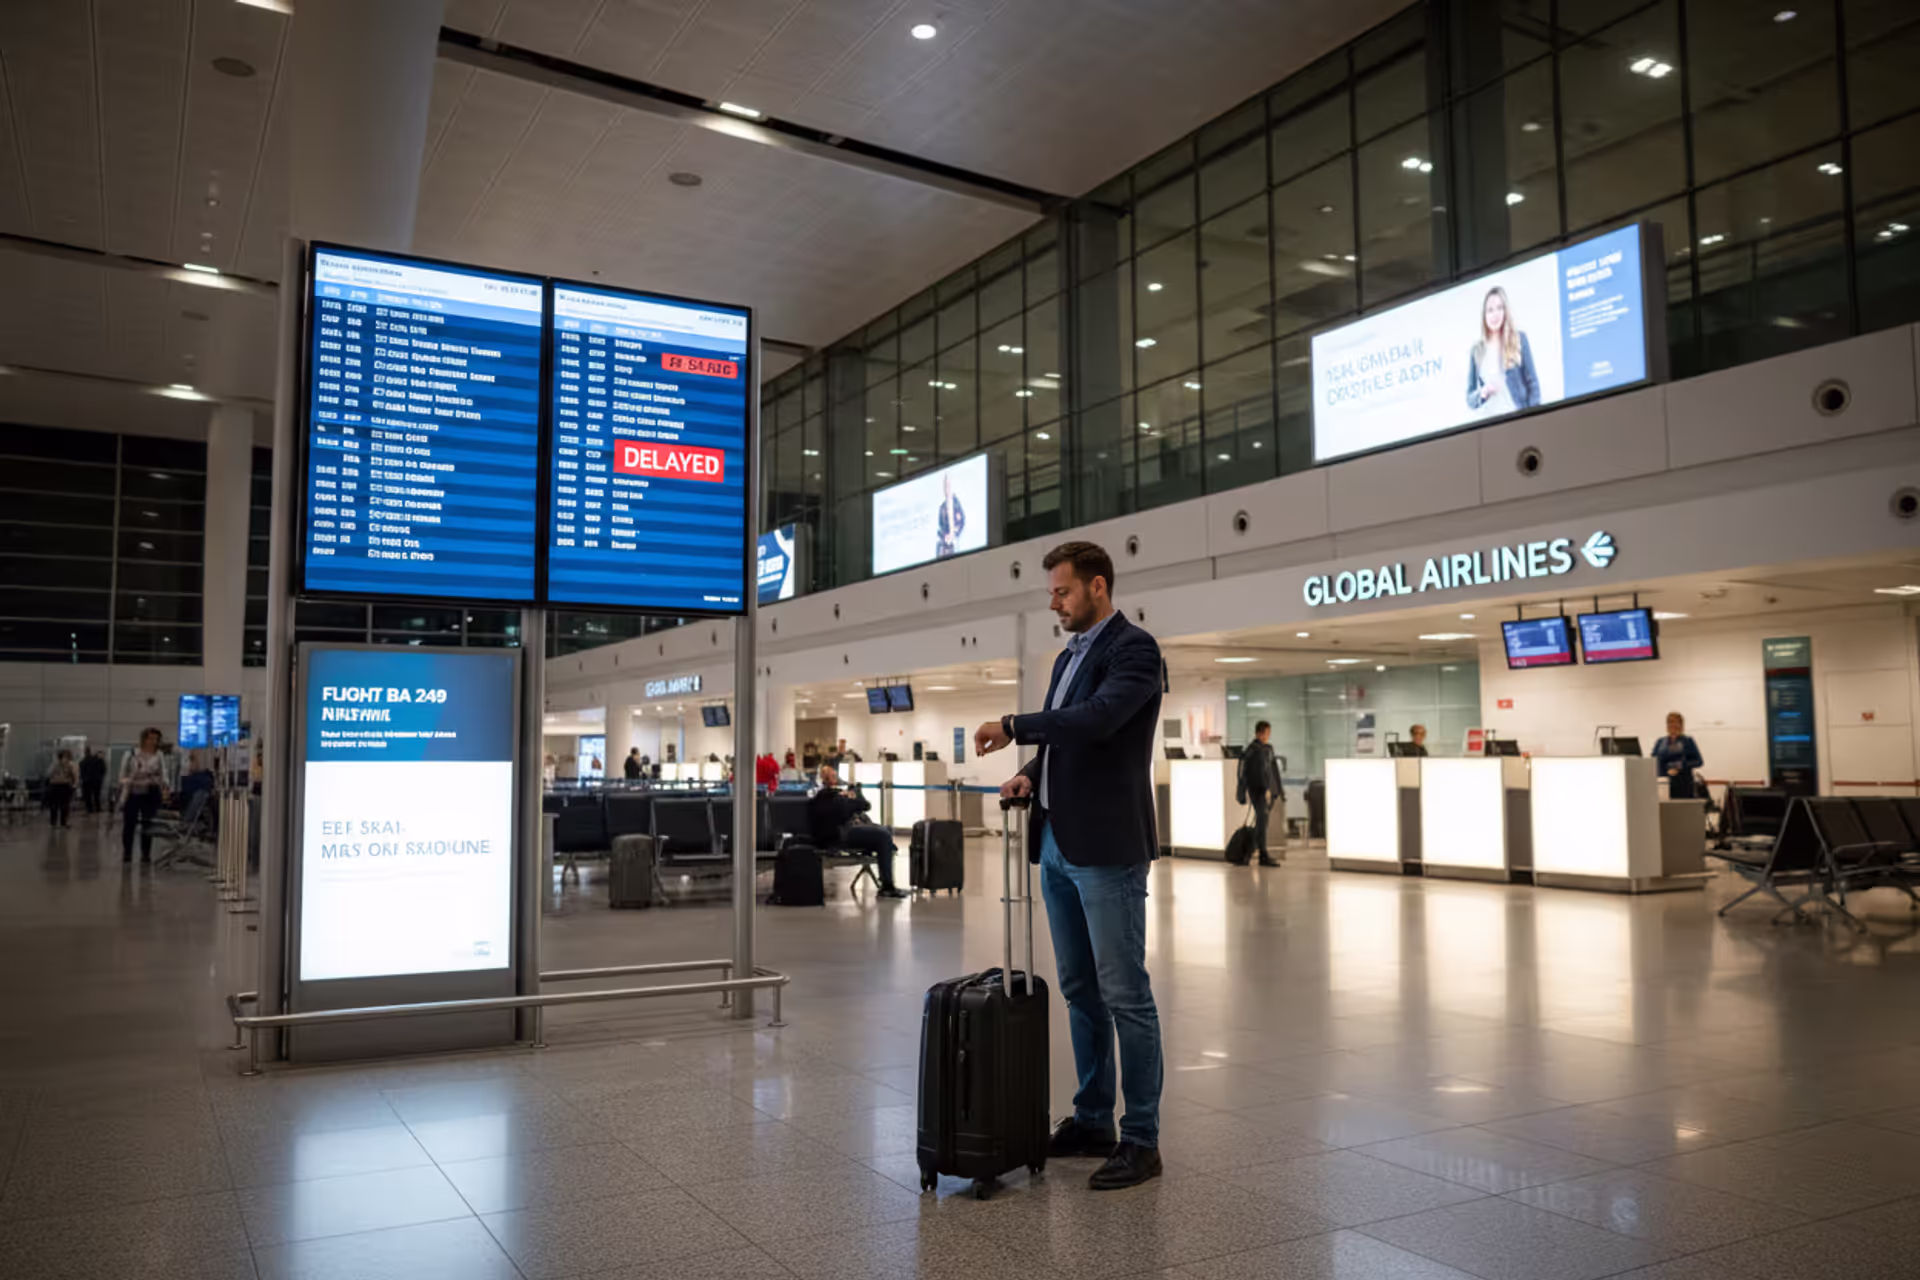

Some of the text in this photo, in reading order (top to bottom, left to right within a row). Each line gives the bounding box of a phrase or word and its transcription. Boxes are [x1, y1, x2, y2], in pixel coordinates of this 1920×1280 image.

[624, 446, 720, 475] DELAYED
[1303, 538, 1573, 606] GLOBAL AIRLINES
[322, 686, 448, 704] FLIGHT BA 249
